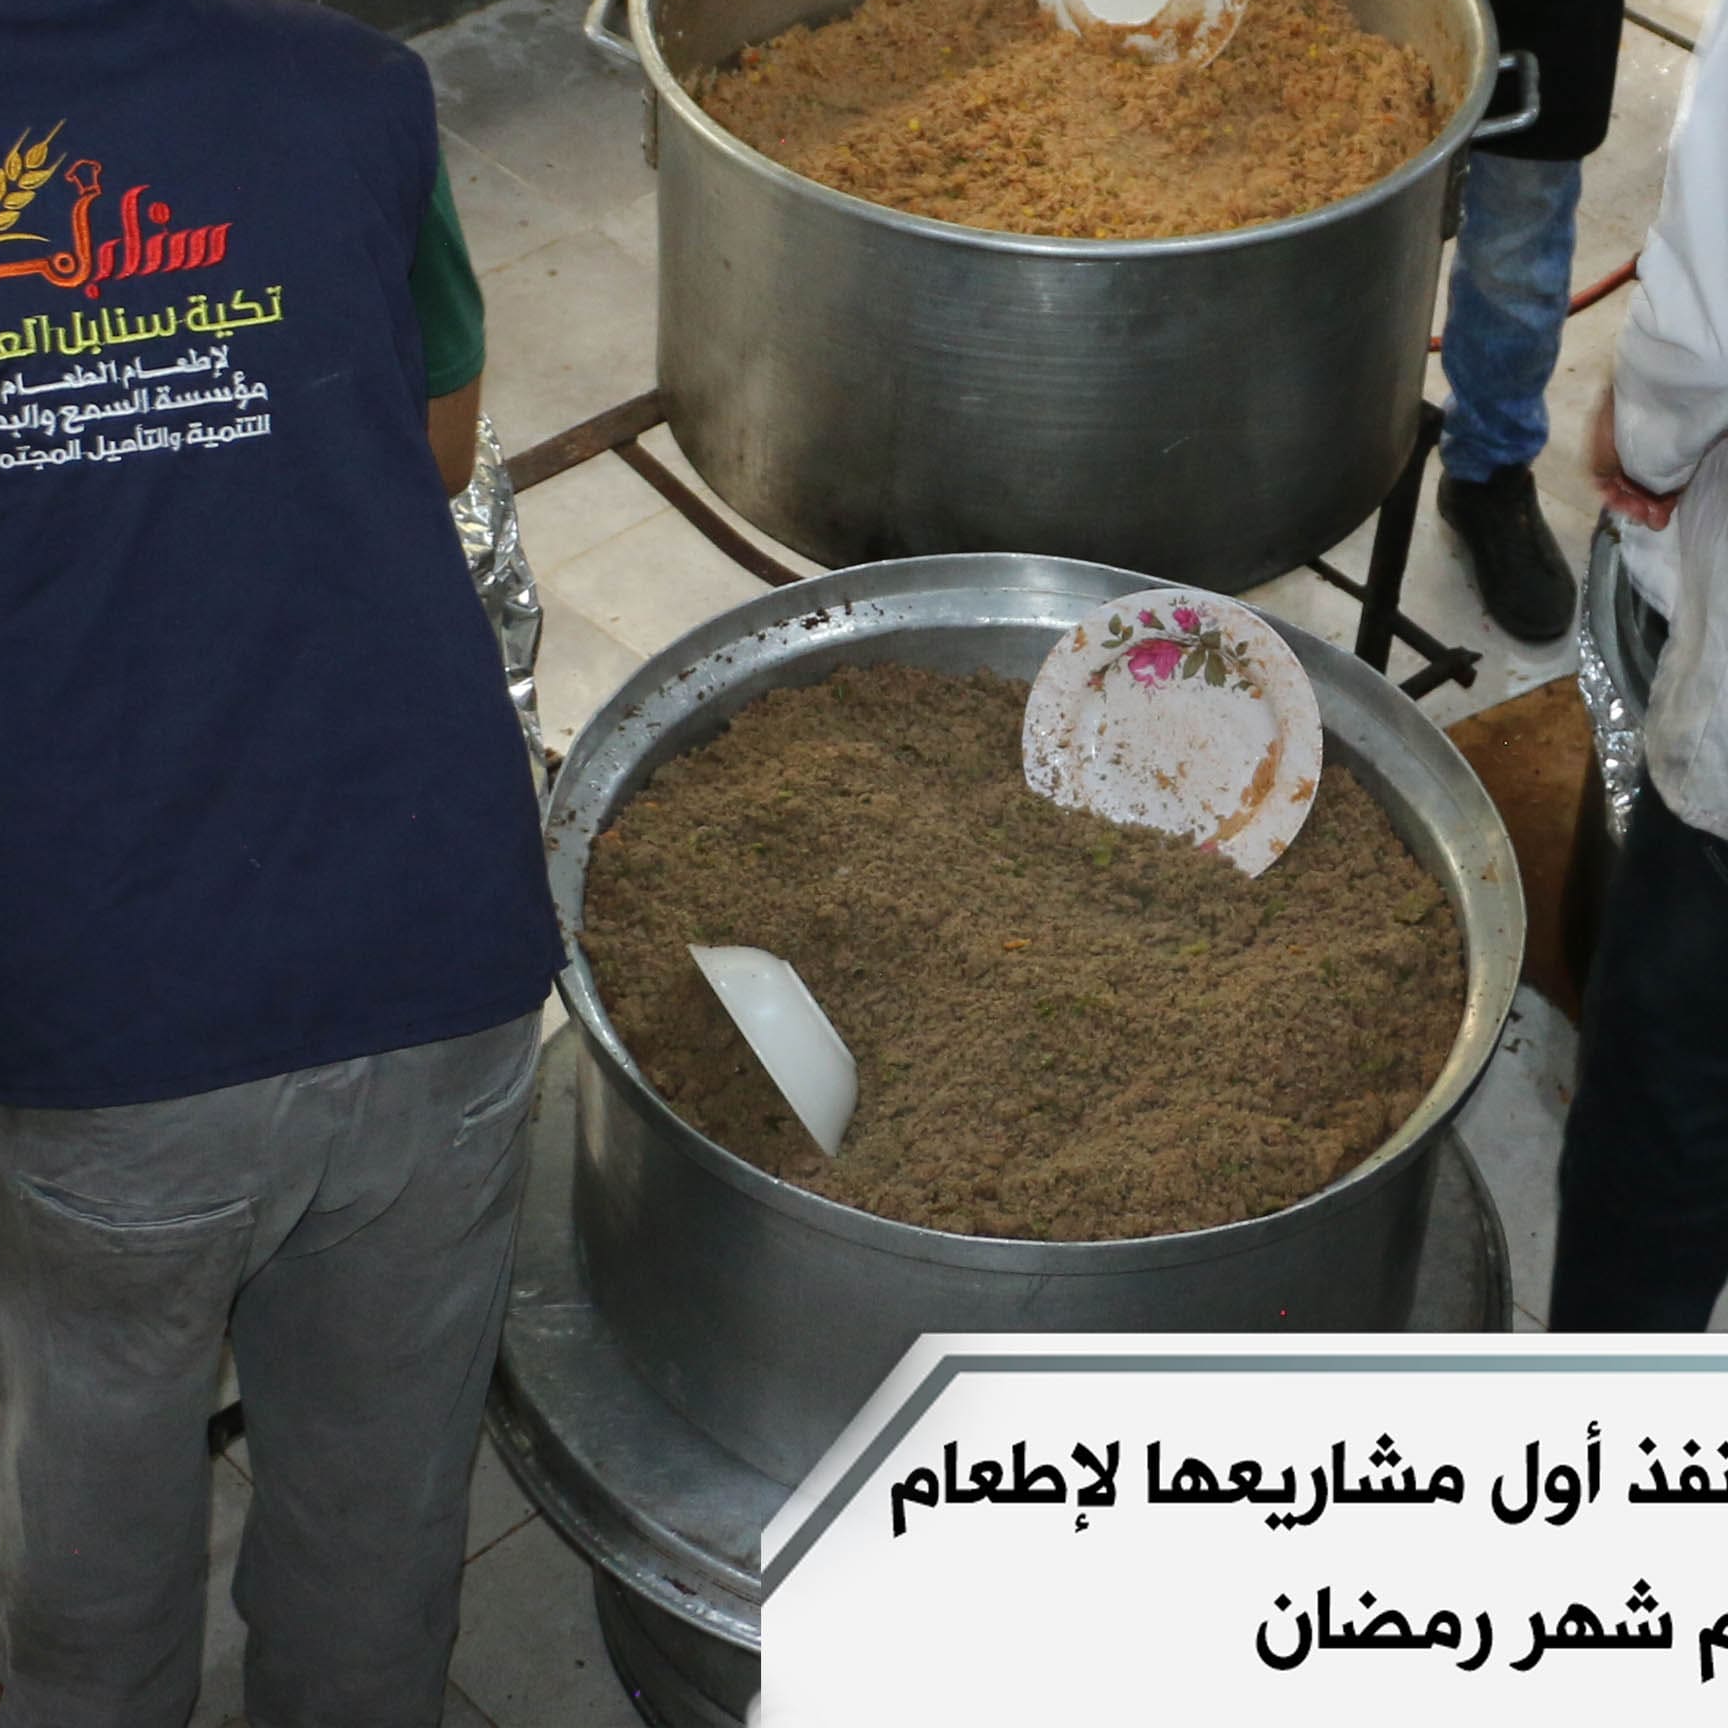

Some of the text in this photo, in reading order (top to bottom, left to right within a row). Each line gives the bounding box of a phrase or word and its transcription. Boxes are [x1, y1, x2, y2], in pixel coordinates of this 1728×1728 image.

[57, 305, 178, 357] سنابل
[183, 284, 284, 339] تكية
[60, 386, 150, 433] السمع
[154, 371, 270, 410] مؤسسة
[86, 423, 183, 463] والتأهيل
